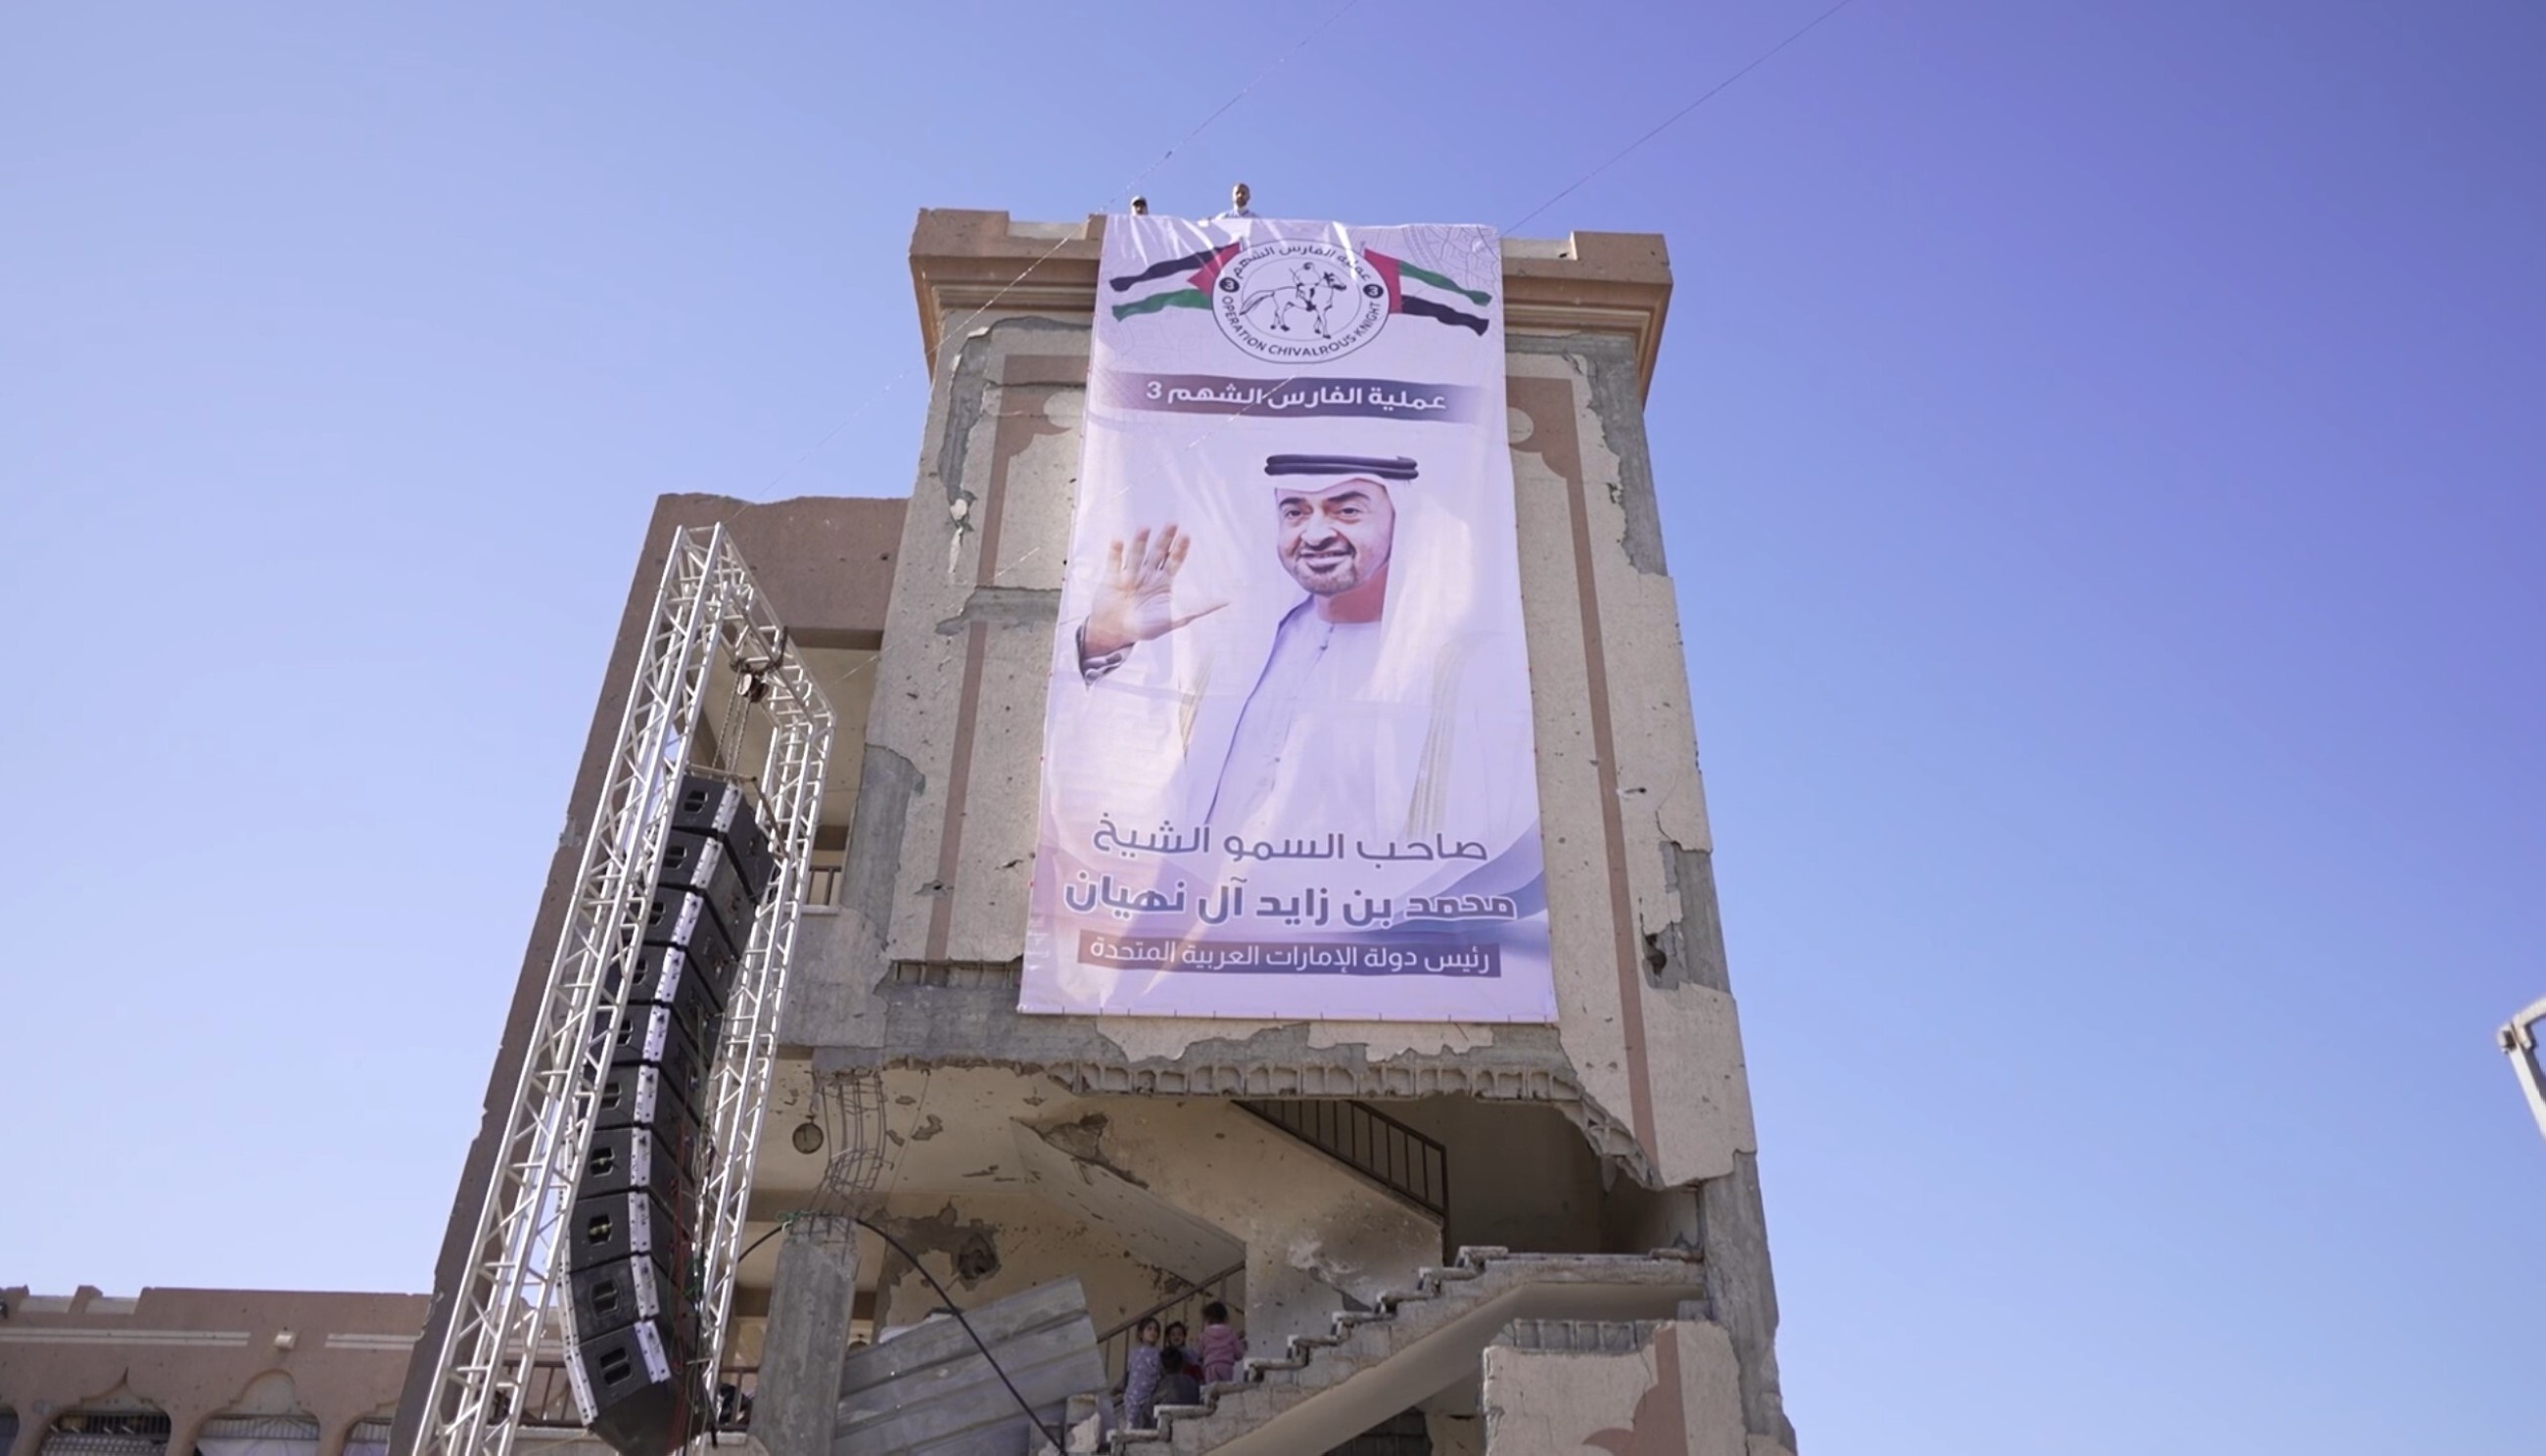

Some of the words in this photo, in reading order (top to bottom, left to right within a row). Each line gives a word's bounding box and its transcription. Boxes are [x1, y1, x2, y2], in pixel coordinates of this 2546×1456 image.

[1234, 247, 1274, 279] الشهم
[1279, 245, 1335, 258] الفارس
[1222, 296, 1266, 351] OPERATION
[1268, 336, 1356, 356] CHIVALROUS
[1355, 303, 1381, 337] KNIGHT
[1147, 381, 1162, 399] 3
[1168, 383, 1262, 404] الشهم
[1268, 388, 1362, 409] الفارس
[1368, 388, 1446, 411] عملية
[1093, 812, 1210, 858] الشيخ
[1224, 833, 1344, 862] السمو
[1357, 833, 1487, 869] صاحب
[1065, 870, 1185, 918] نهيان
[1199, 876, 1248, 924] آل
[1256, 887, 1329, 926] زايد
[1343, 889, 1392, 929] بن
[1404, 895, 1517, 921] محمد
[1090, 937, 1176, 963] المتحدة
[1181, 944, 1259, 970] العربية
[1265, 946, 1358, 973] الإمارات
[1364, 948, 1417, 972] دولة
[1424, 947, 1489, 973] رئيس
